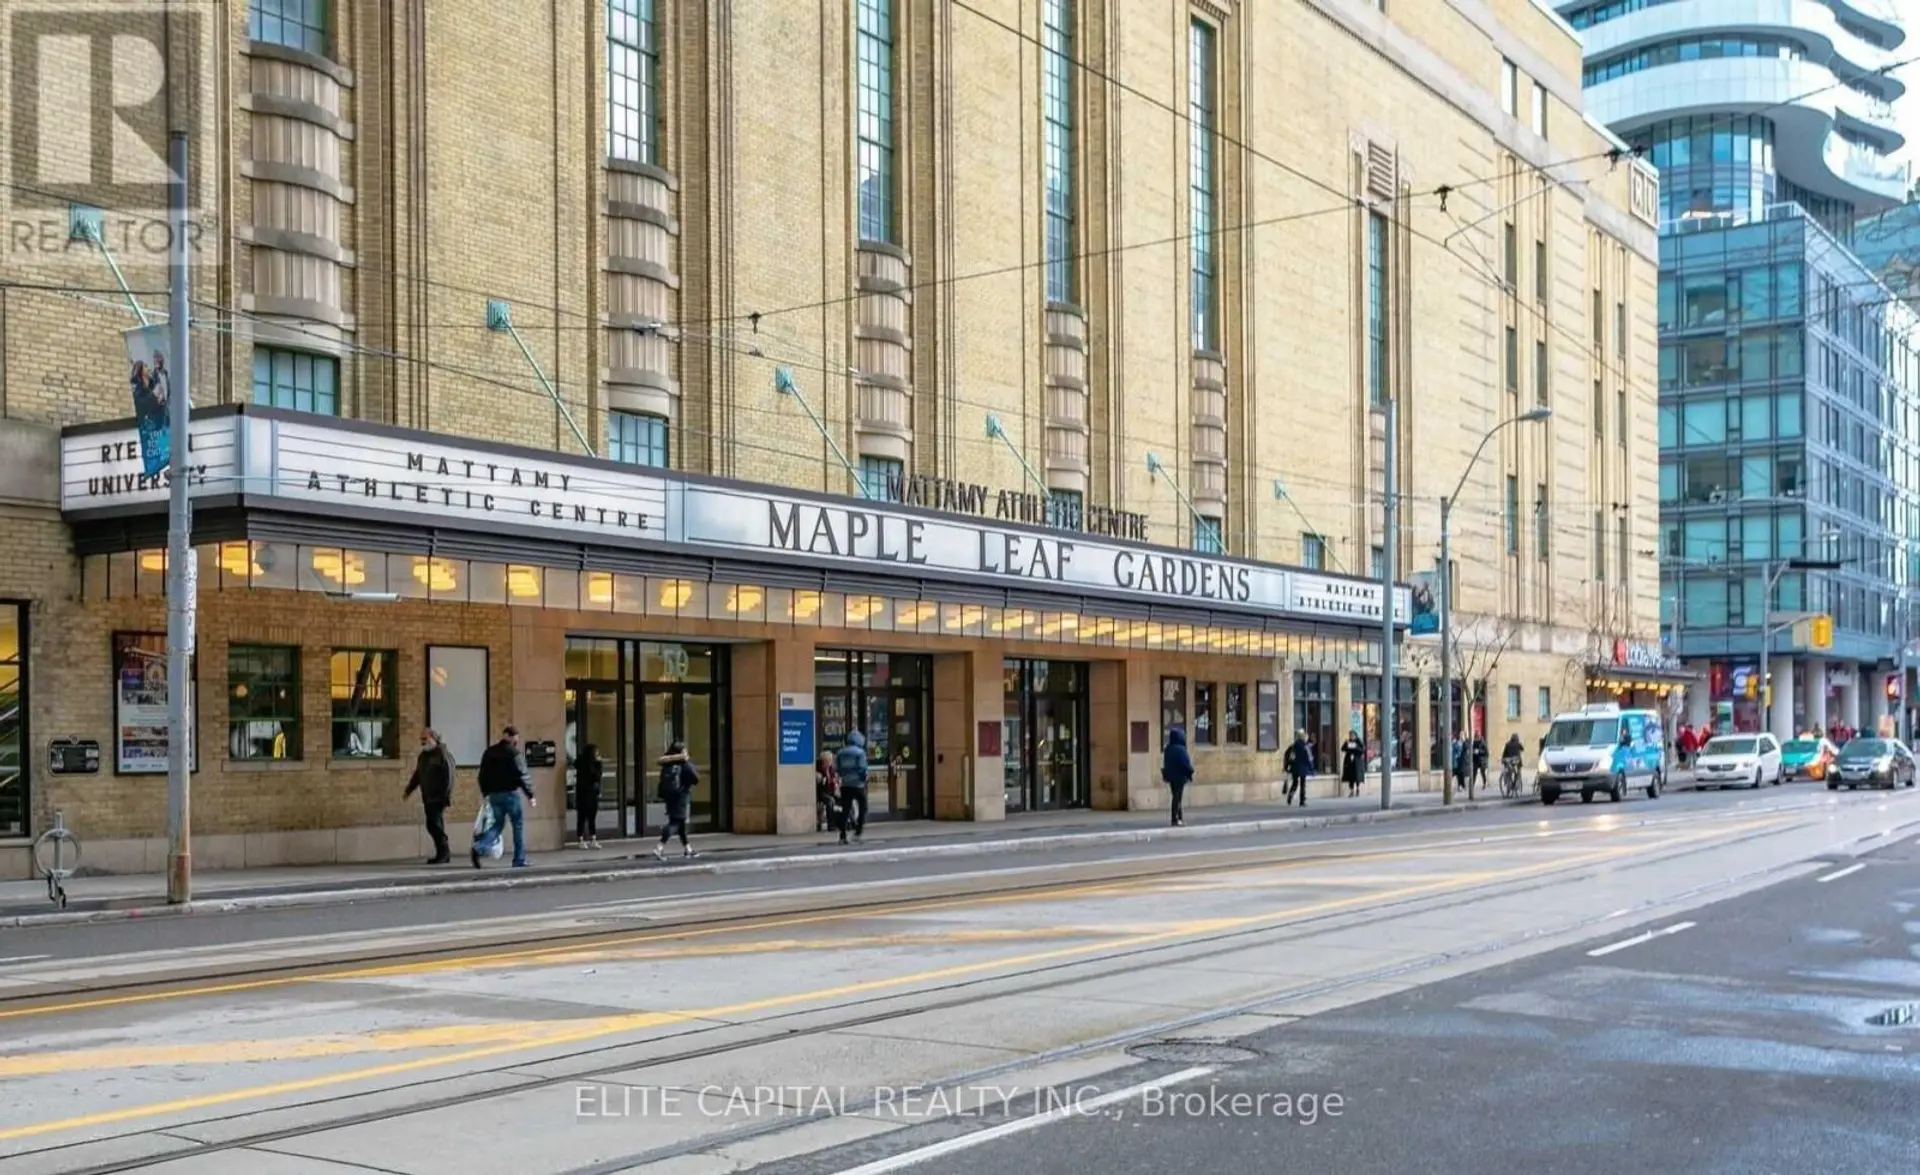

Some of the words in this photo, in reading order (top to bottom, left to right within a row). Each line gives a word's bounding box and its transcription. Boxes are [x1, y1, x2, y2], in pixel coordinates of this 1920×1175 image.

[88, 465, 207, 496] UNIVERSTY
[407, 452, 571, 492] MATTAMY
[307, 470, 495, 511] ATHLETIC
[530, 500, 649, 530] CENTRE
[886, 471, 989, 514] MATTAMY
[996, 489, 1079, 530] ATHLETIC
[1087, 504, 1149, 541] CENTRE
[769, 500, 927, 564] MAPLE
[979, 530, 1074, 581] LEAF
[1114, 550, 1251, 601] GARDENS
[1361, 604, 1399, 618] CENE
